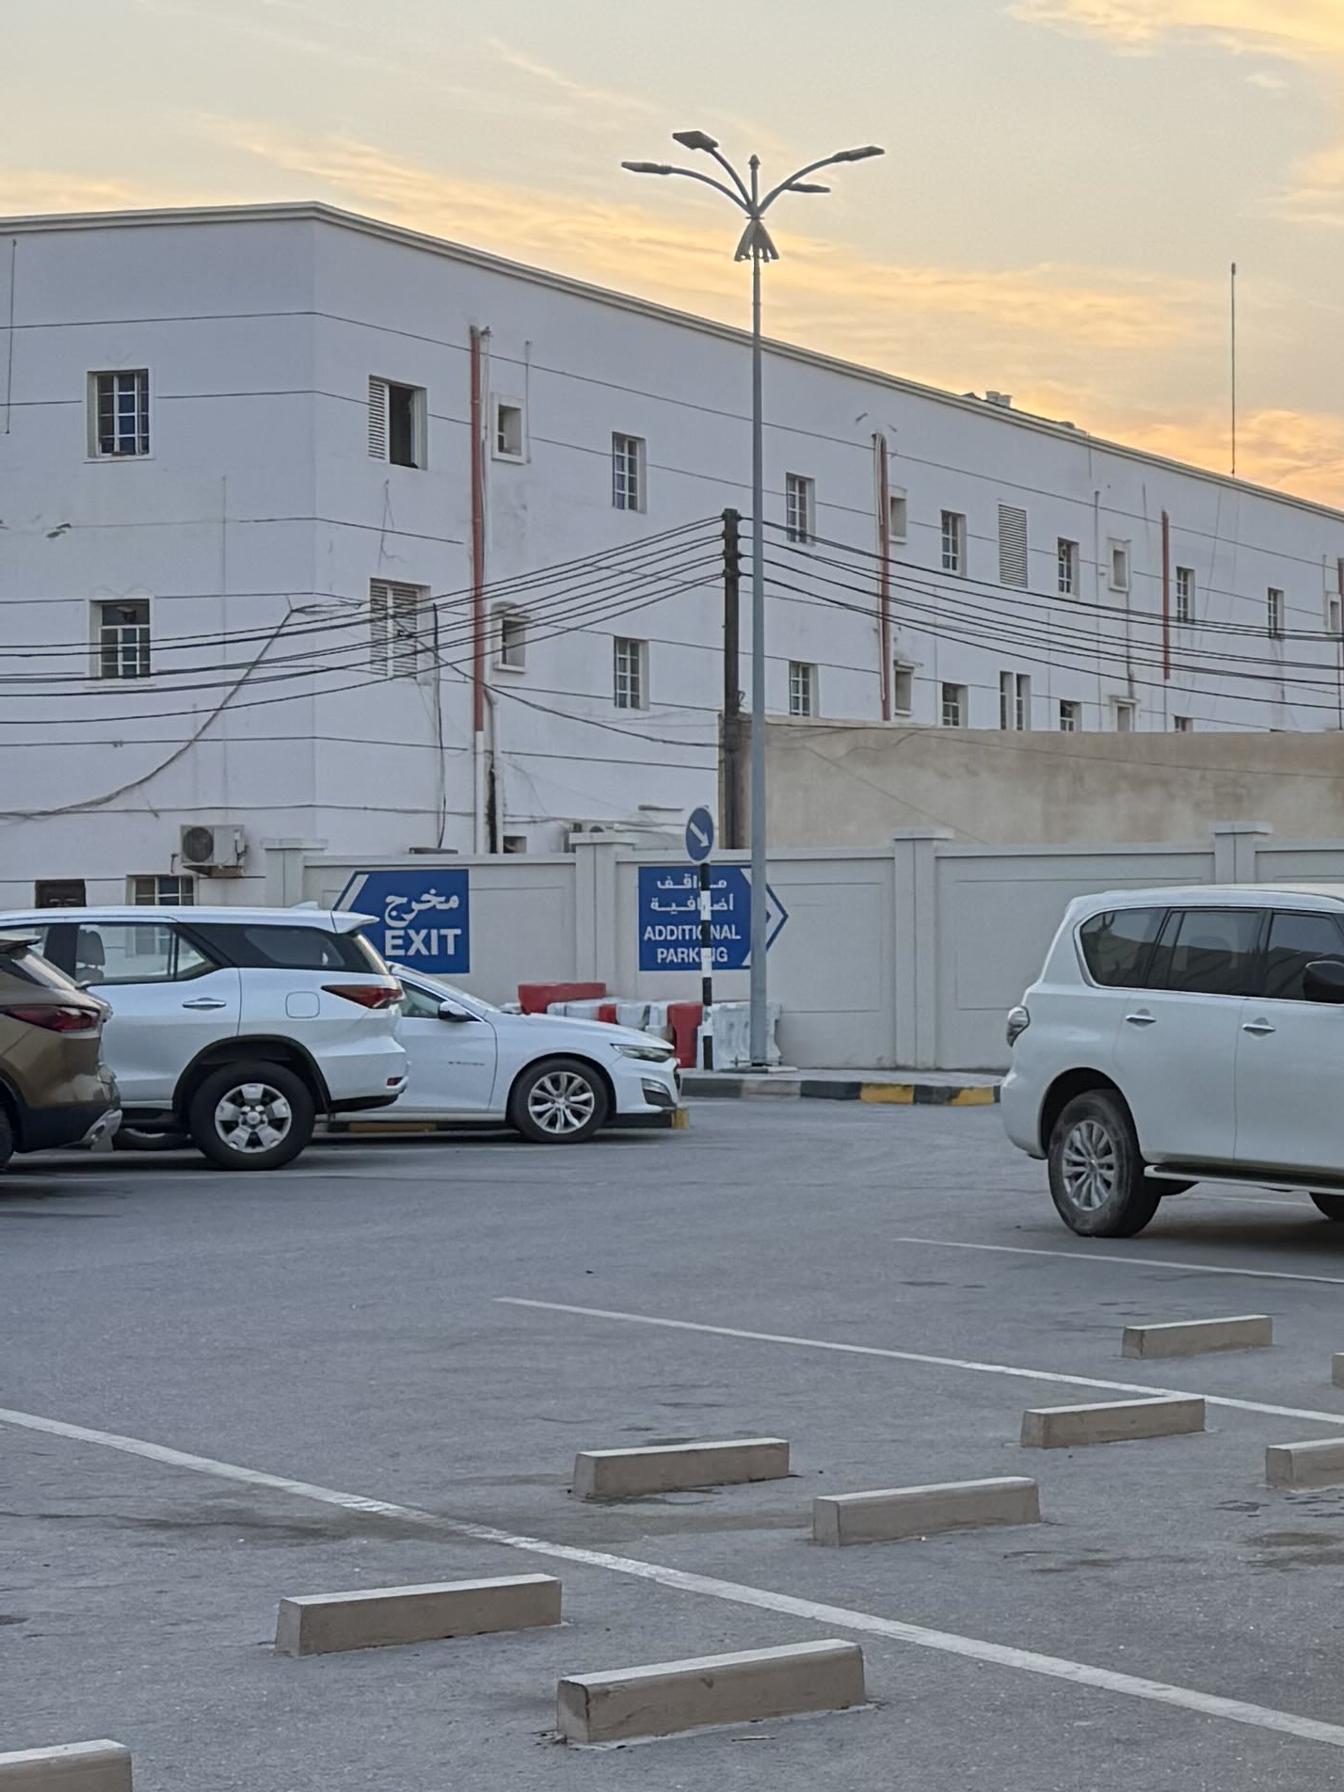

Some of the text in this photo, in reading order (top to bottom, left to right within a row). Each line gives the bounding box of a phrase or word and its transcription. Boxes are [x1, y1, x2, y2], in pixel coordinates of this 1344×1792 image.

[657, 873, 727, 889] ماقف
[384, 888, 460, 928] مخرج
[384, 928, 462, 956] EXIT
[656, 947, 728, 963] PARKG
